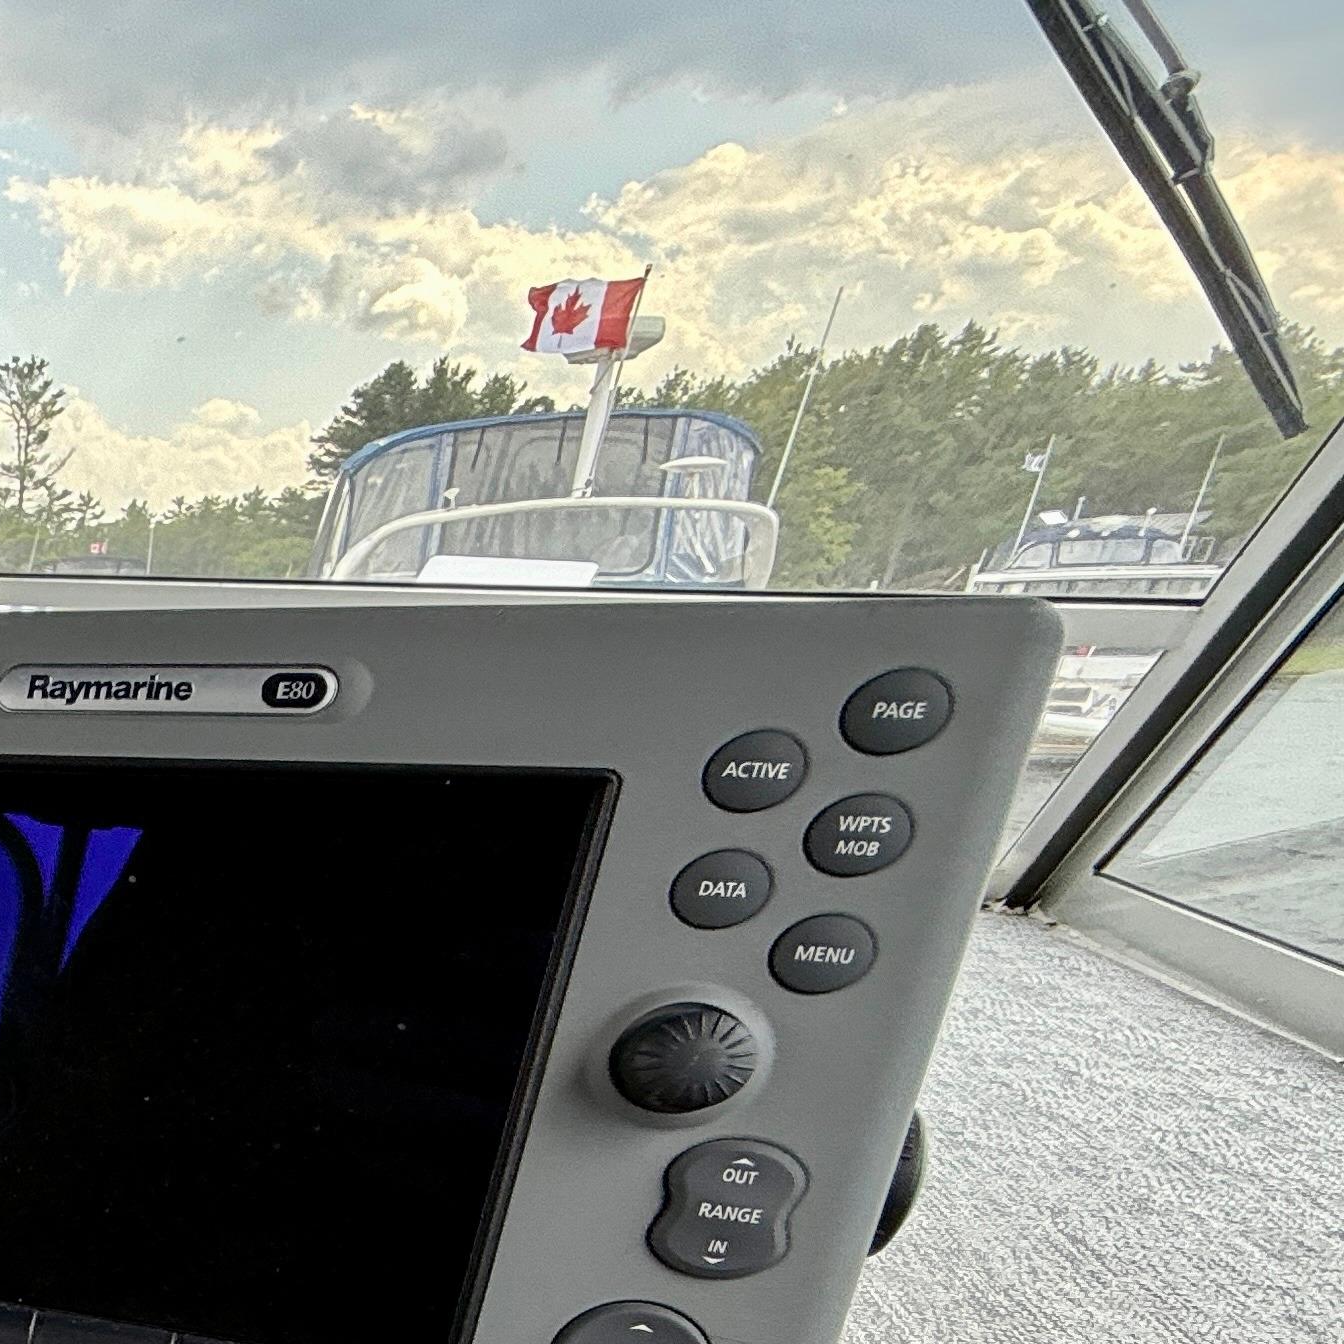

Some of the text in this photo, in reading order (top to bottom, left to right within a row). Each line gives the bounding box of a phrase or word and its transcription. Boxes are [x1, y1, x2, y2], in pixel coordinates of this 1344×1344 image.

[27, 675, 315, 705] Raymarine E80
[872, 702, 928, 719] PAGE
[721, 761, 791, 780] ACTIVE
[839, 815, 892, 833] WPTS
[835, 840, 880, 857] MOB
[698, 881, 747, 898] DATA
[794, 946, 855, 964] MENU
[722, 1168, 759, 1186] OUT
[698, 1202, 764, 1225] RANGE
[708, 1239, 727, 1255] IN
